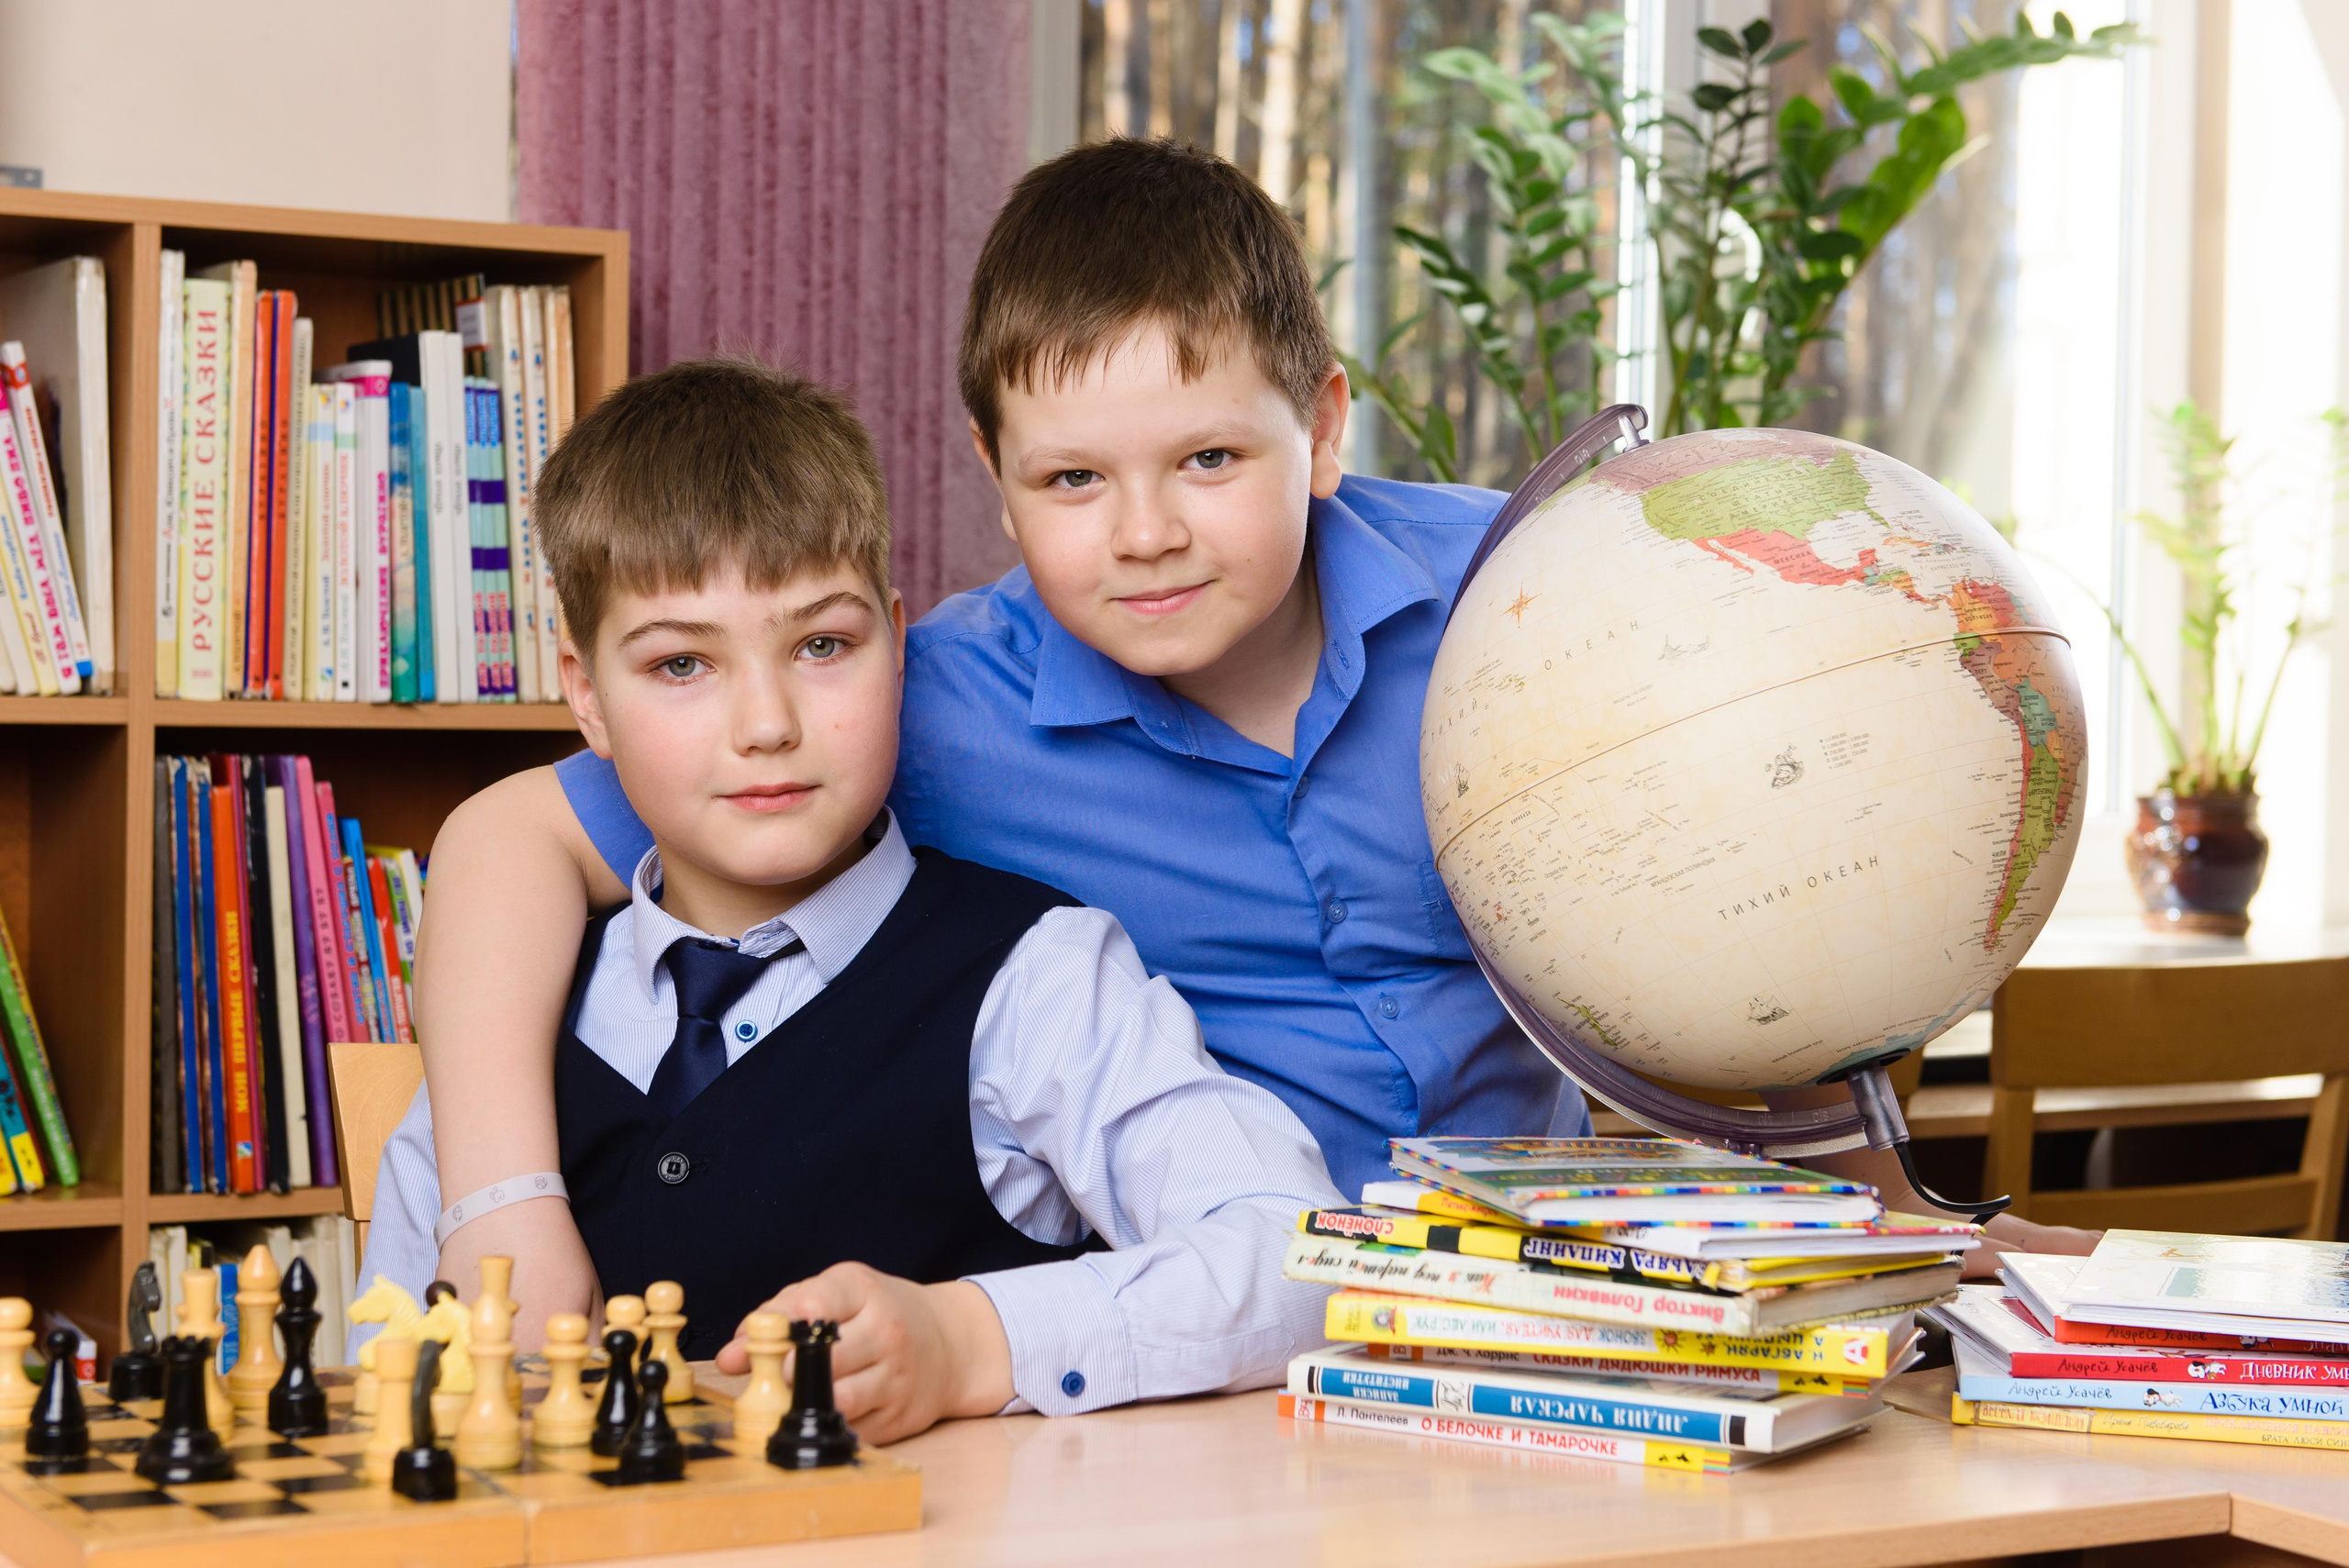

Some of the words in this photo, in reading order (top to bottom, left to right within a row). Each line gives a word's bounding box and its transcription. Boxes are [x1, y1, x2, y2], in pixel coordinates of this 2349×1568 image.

[195, 310, 217, 465] СКАЗКИ
[377, 471, 387, 555] БУРАТИНО
[192, 479, 215, 652] РУССКИЕ
[1773, 550, 1811, 565] МЕКСИКА
[1431, 697, 1478, 742] ТИХИЙ
[1544, 620, 1639, 671] ОКЕАН
[1718, 884, 1791, 920] ТИХИЙ
[1807, 855, 1879, 888] ОКЕАН
[337, 882, 355, 953] СТАРУШКА
[226, 911, 242, 984] СКАЗКИ
[229, 991, 246, 1064] ПЕРВЫЕ
[233, 1071, 250, 1113] МОИ
[1316, 1212, 1395, 1237] СЛОНЁНОК
[1527, 1238, 1624, 1267] КИПЛИНГ
[1414, 1265, 1441, 1282] под
[1553, 1284, 1644, 1314] Голявкин
[1653, 1296, 1725, 1325] Виктор
[1414, 1315, 1438, 1329] РУК
[1441, 1318, 1468, 1332] ЛЕС
[1472, 1321, 1497, 1334] ИЛИ
[1566, 1326, 1595, 1342] ДЛЯ
[1597, 1329, 1647, 1346] ЗВОНОК
[1342, 1371, 1409, 1390] ИНСТИТУТКИ
[1532, 1353, 1594, 1368] СКАЗКИ
[1598, 1359, 1690, 1376] ДЯДЮШКИ
[1695, 1365, 1762, 1383] РИМУСА
[2057, 1359, 2110, 1375] Андрей
[2115, 1359, 2158, 1374] Усачёв
[1353, 1387, 1400, 1403] ЗАПИСКИ
[2008, 1381, 2062, 1399] Андрей
[2065, 1385, 2112, 1401] Усачёв
[1510, 1396, 1604, 1424] ЧАРСКАЯ
[1613, 1407, 1689, 1434] ЛИДИЯ
[1351, 1407, 1408, 1426] Пантелеев
[1421, 1417, 1432, 1430] О
[1438, 1419, 1504, 1441] БЕЛОЧКЕ
[1511, 1427, 1521, 1442] И
[1529, 1429, 1619, 1456] ТАМАРОЧКЕ
[2204, 1417, 2299, 1433] ПРИКЛЮЧЕНИЯ
[2261, 1434, 2288, 1444] БРАТА
[2294, 1437, 2323, 1447] ЛЮСИ
